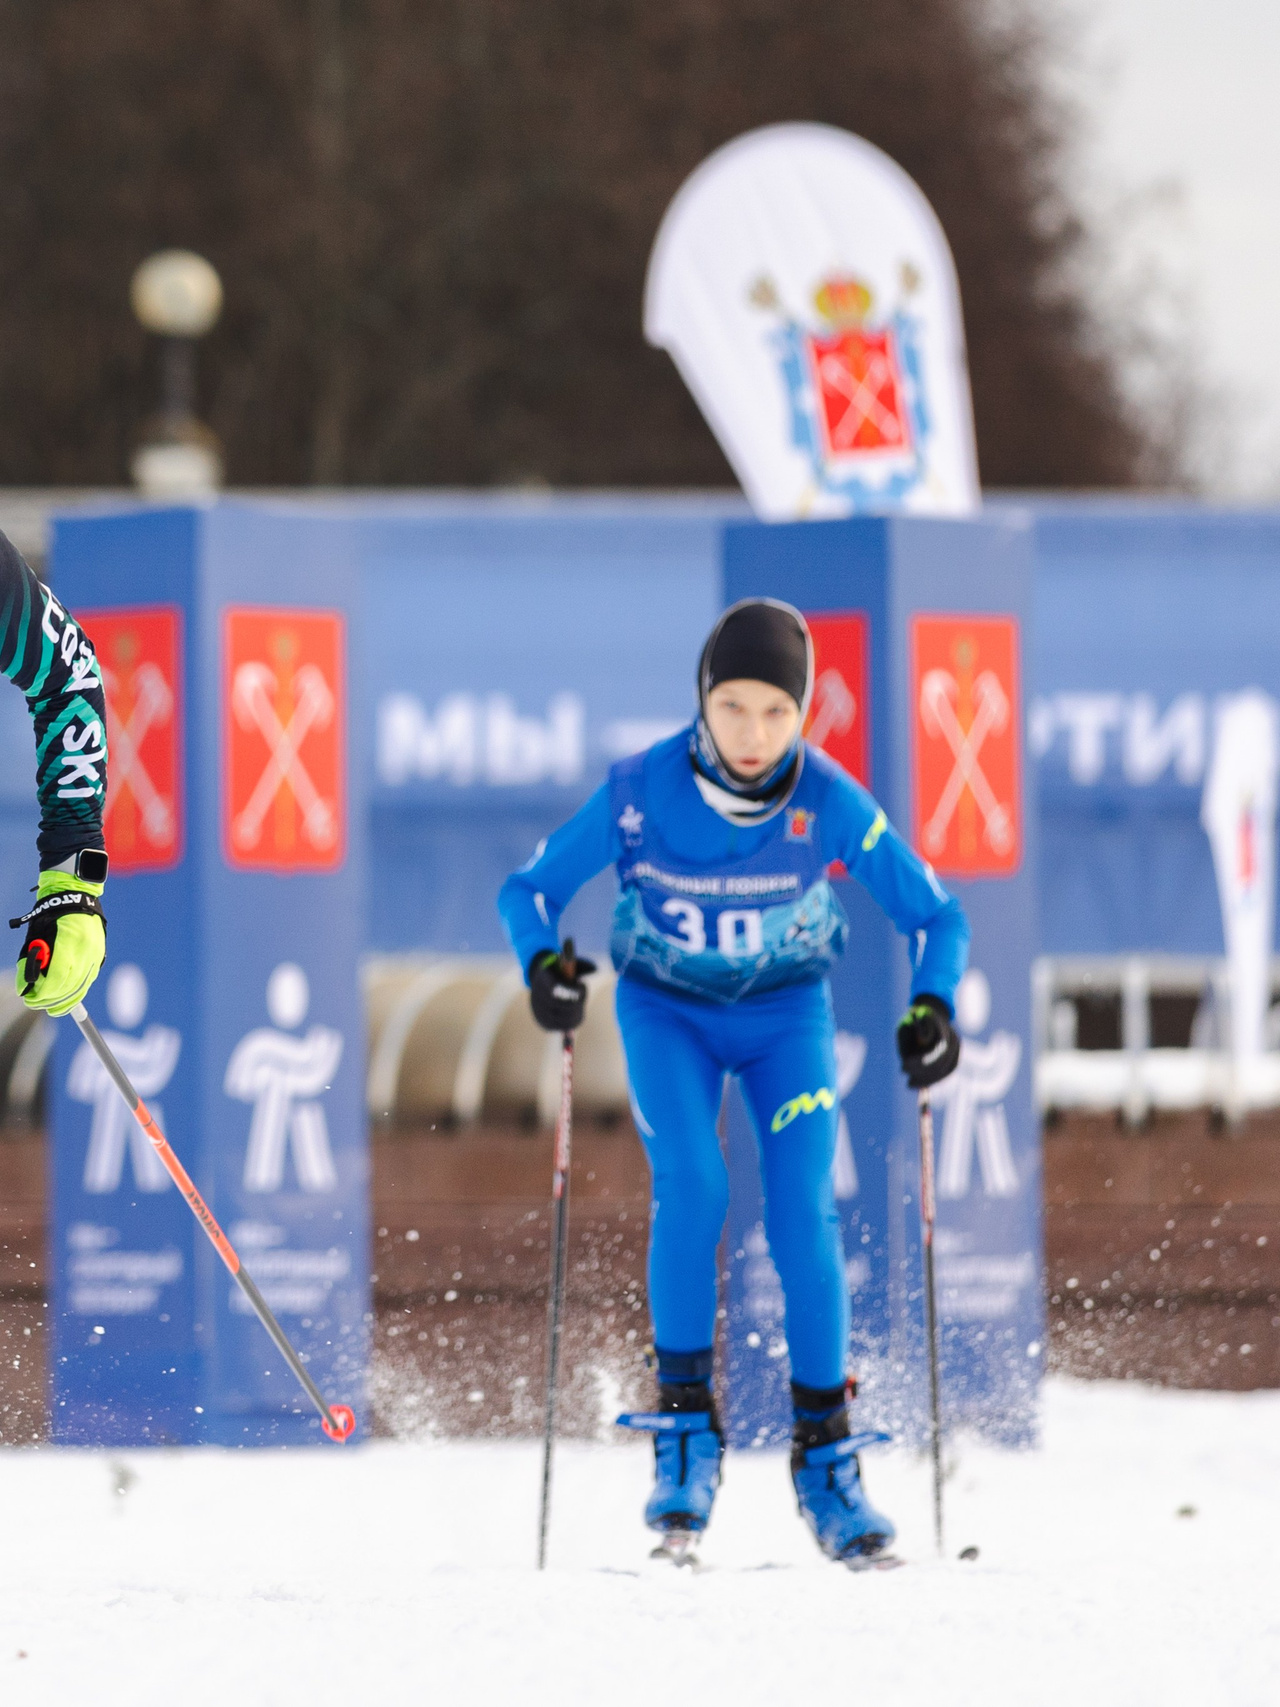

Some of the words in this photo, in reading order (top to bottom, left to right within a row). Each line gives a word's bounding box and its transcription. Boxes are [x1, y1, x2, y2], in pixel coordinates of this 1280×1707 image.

[57, 720, 107, 798] ski
[376, 693, 584, 786] МЫ
[21, 894, 82, 921] ATOMIC
[662, 899, 763, 958] 30
